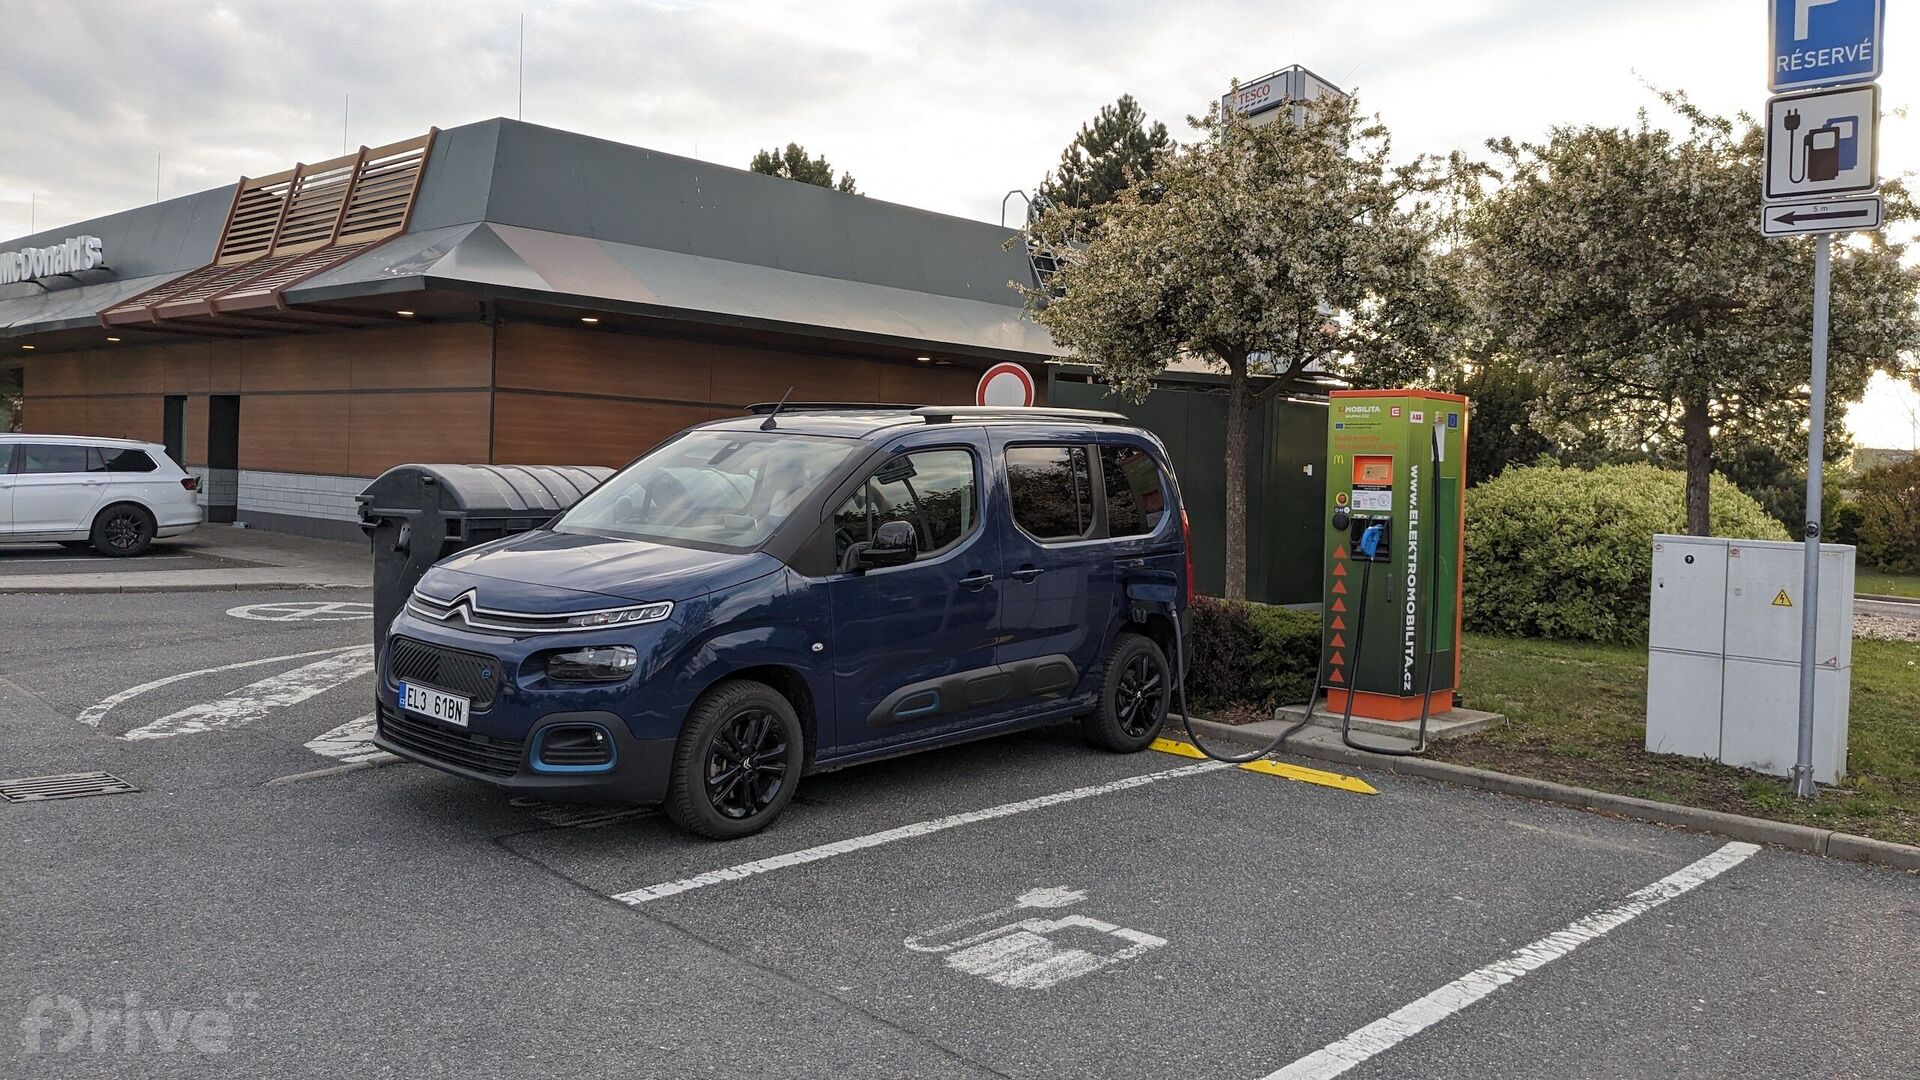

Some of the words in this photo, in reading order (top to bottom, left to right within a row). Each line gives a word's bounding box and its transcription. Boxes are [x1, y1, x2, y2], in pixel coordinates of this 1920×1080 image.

[1776, 38, 1872, 73] RÉSERVÉ
[1239, 84, 1270, 105] TESCO
[407, 687, 427, 711] EL3
[434, 695, 463, 722] 61BN
